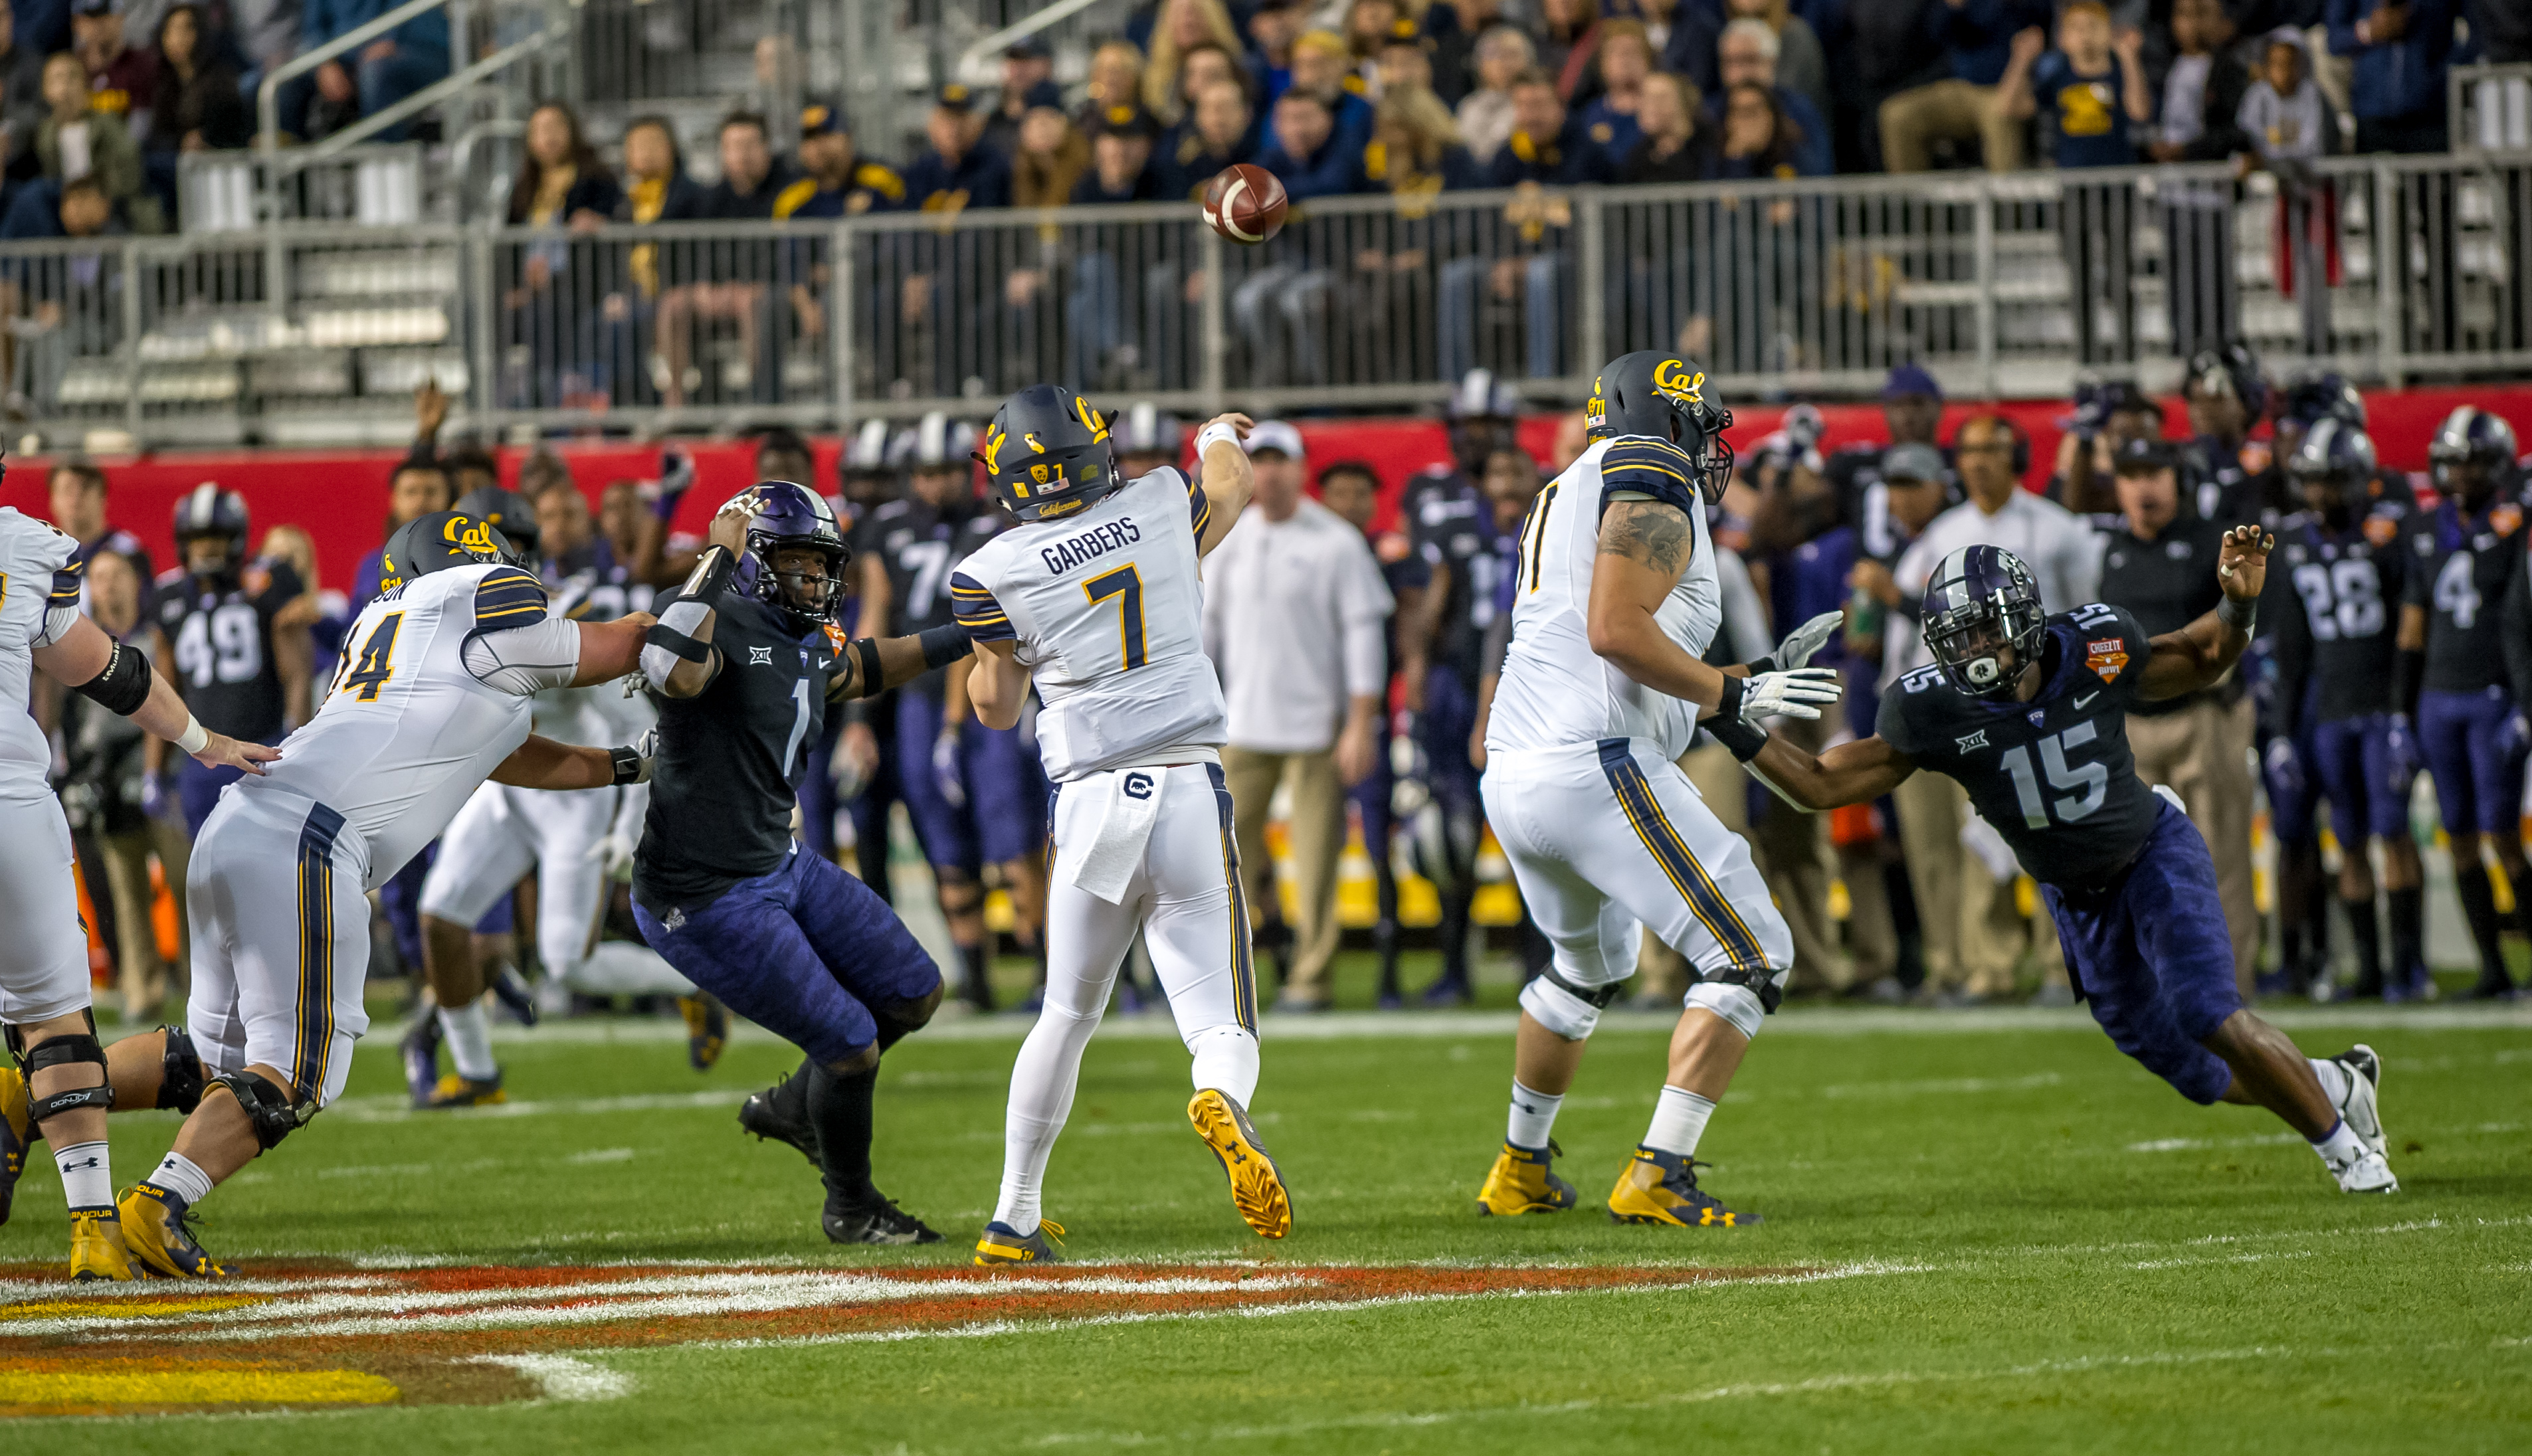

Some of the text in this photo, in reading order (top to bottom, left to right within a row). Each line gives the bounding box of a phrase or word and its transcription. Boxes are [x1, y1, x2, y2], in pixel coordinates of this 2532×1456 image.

[1652, 359, 1705, 403] Cal
[1076, 397, 1109, 444] Ca
[1595, 399, 1605, 416] 71
[1039, 500, 1082, 517] California
[444, 516, 498, 555] Cal
[1041, 517, 1141, 576] GARBERS
[2434, 550, 2482, 630] 4
[1082, 561, 1149, 671] 7
[174, 603, 262, 688] 49
[2090, 641, 2113, 654] CHEEZ
[1900, 664, 1946, 693] 15
[2098, 665, 2120, 676] BOWL
[784, 677, 810, 779] 1
[1123, 772, 1154, 800] C
[2000, 720, 2109, 830] 15
